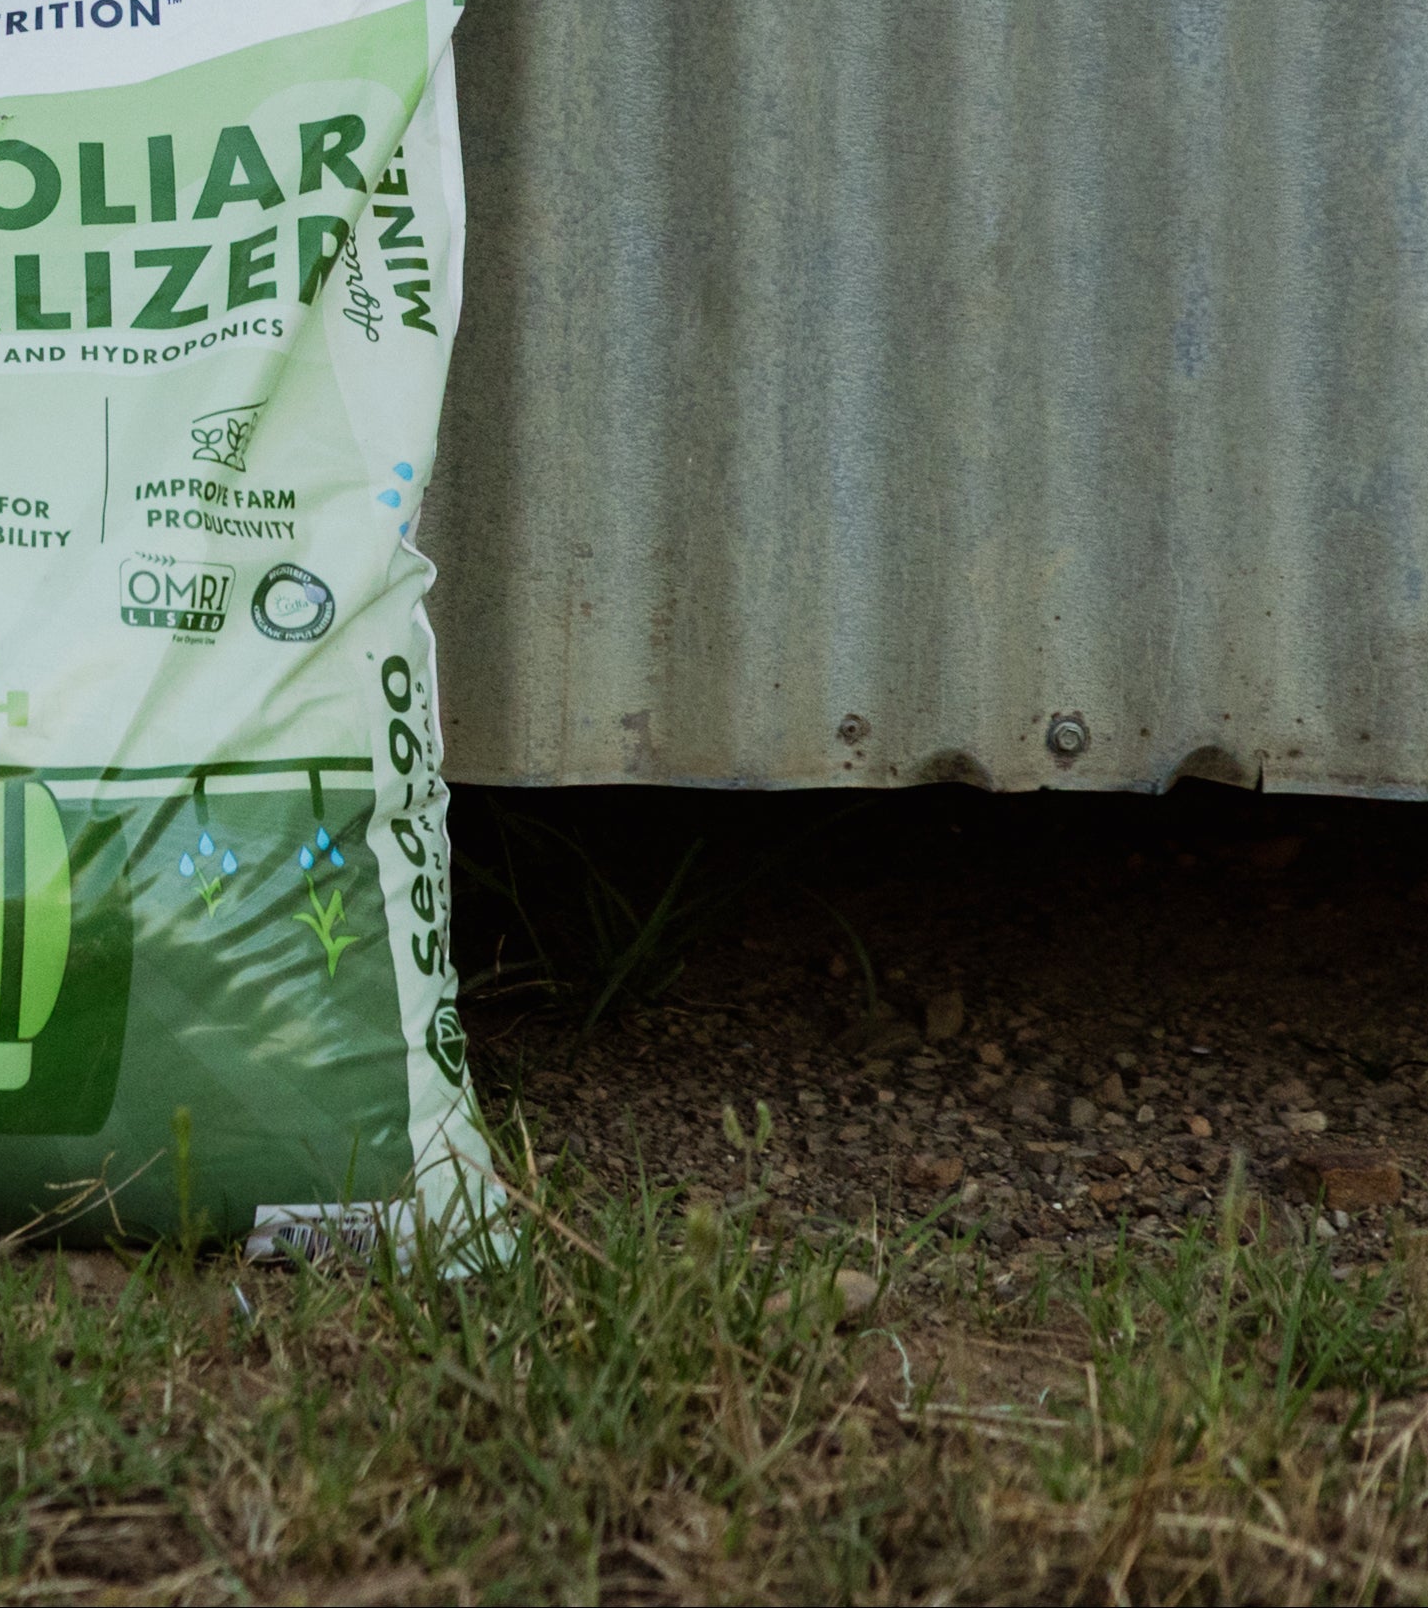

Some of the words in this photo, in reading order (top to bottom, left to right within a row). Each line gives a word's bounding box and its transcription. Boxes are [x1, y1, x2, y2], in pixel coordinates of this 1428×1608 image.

[2, 344, 69, 365] AND
[79, 318, 284, 365] HYDROPONICS
[234, 489, 298, 511] FARM
[145, 508, 298, 541] PRODUCTIVITY
[129, 571, 230, 611] OMRI
[128, 609, 221, 631] LISTED
[381, 655, 446, 978] Sea-90
